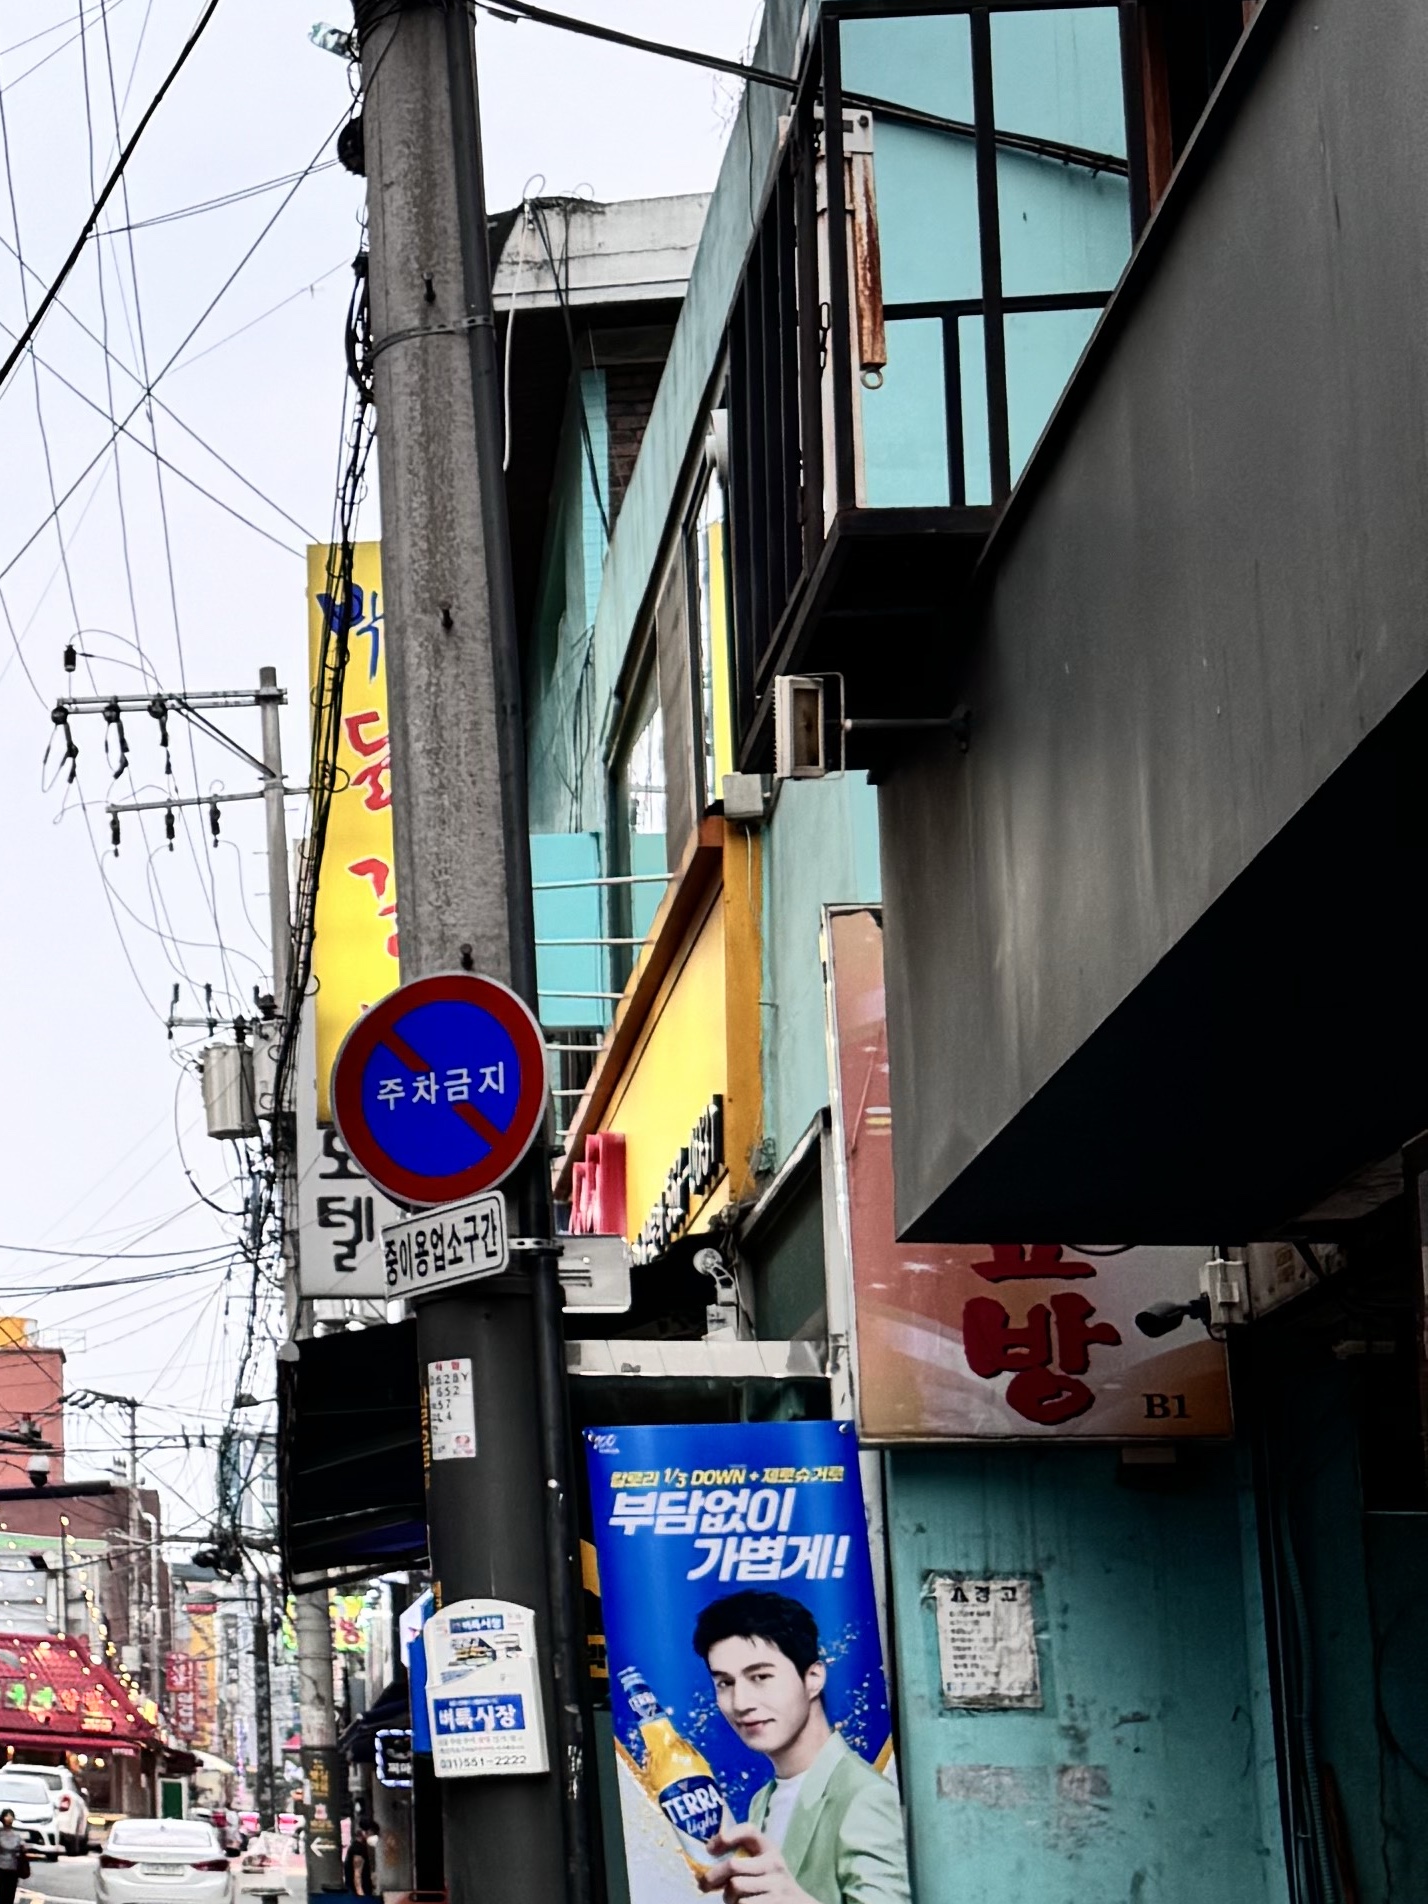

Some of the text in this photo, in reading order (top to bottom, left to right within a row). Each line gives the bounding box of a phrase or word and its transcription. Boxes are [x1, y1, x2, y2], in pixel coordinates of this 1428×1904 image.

[377, 1061, 505, 1111] 주차금지
[1144, 1393, 1191, 1420] B1
[691, 1469, 746, 1486] DOWN
[609, 1487, 796, 1536] 부담없이
[686, 1534, 851, 1582] 가볍게!
[662, 1783, 724, 1828] TERRA
